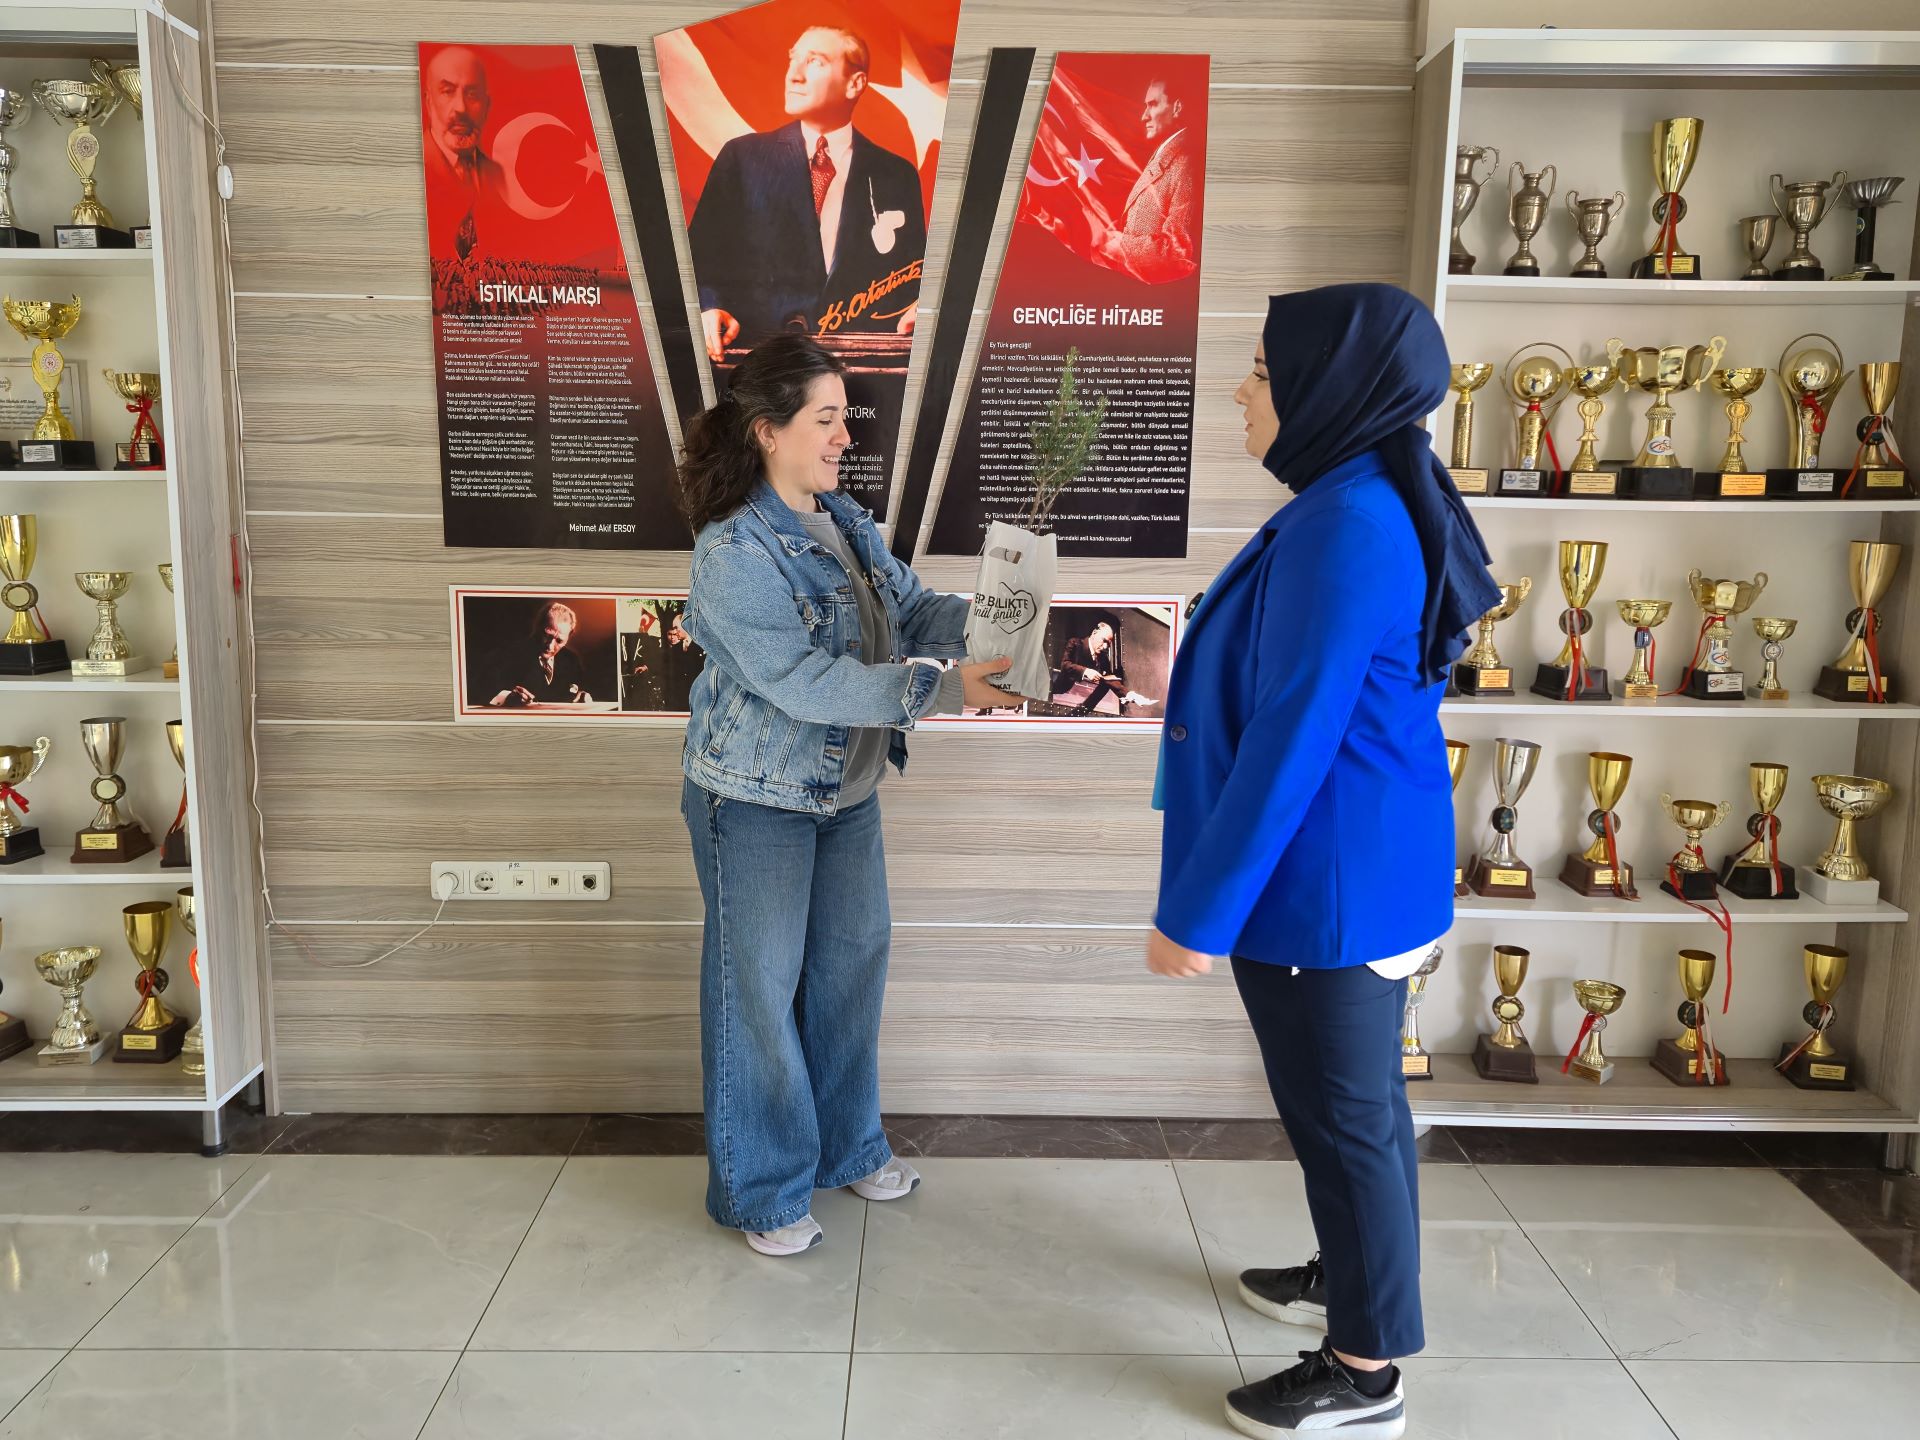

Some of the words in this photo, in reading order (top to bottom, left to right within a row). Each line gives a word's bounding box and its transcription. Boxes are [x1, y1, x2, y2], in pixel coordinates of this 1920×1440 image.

[480, 280, 548, 304] İSTİKLAL
[552, 286, 600, 307] MARŞI
[1013, 304, 1096, 326] GENÇLİĞE
[1102, 304, 1164, 326] HİTABE
[990, 340, 996, 350] Ey
[1114, 464, 1128, 473] sahip
[985, 511, 991, 520] Ey
[569, 523, 597, 532] Mehmet
[598, 523, 612, 532] Akif
[613, 524, 636, 533] ERSOY
